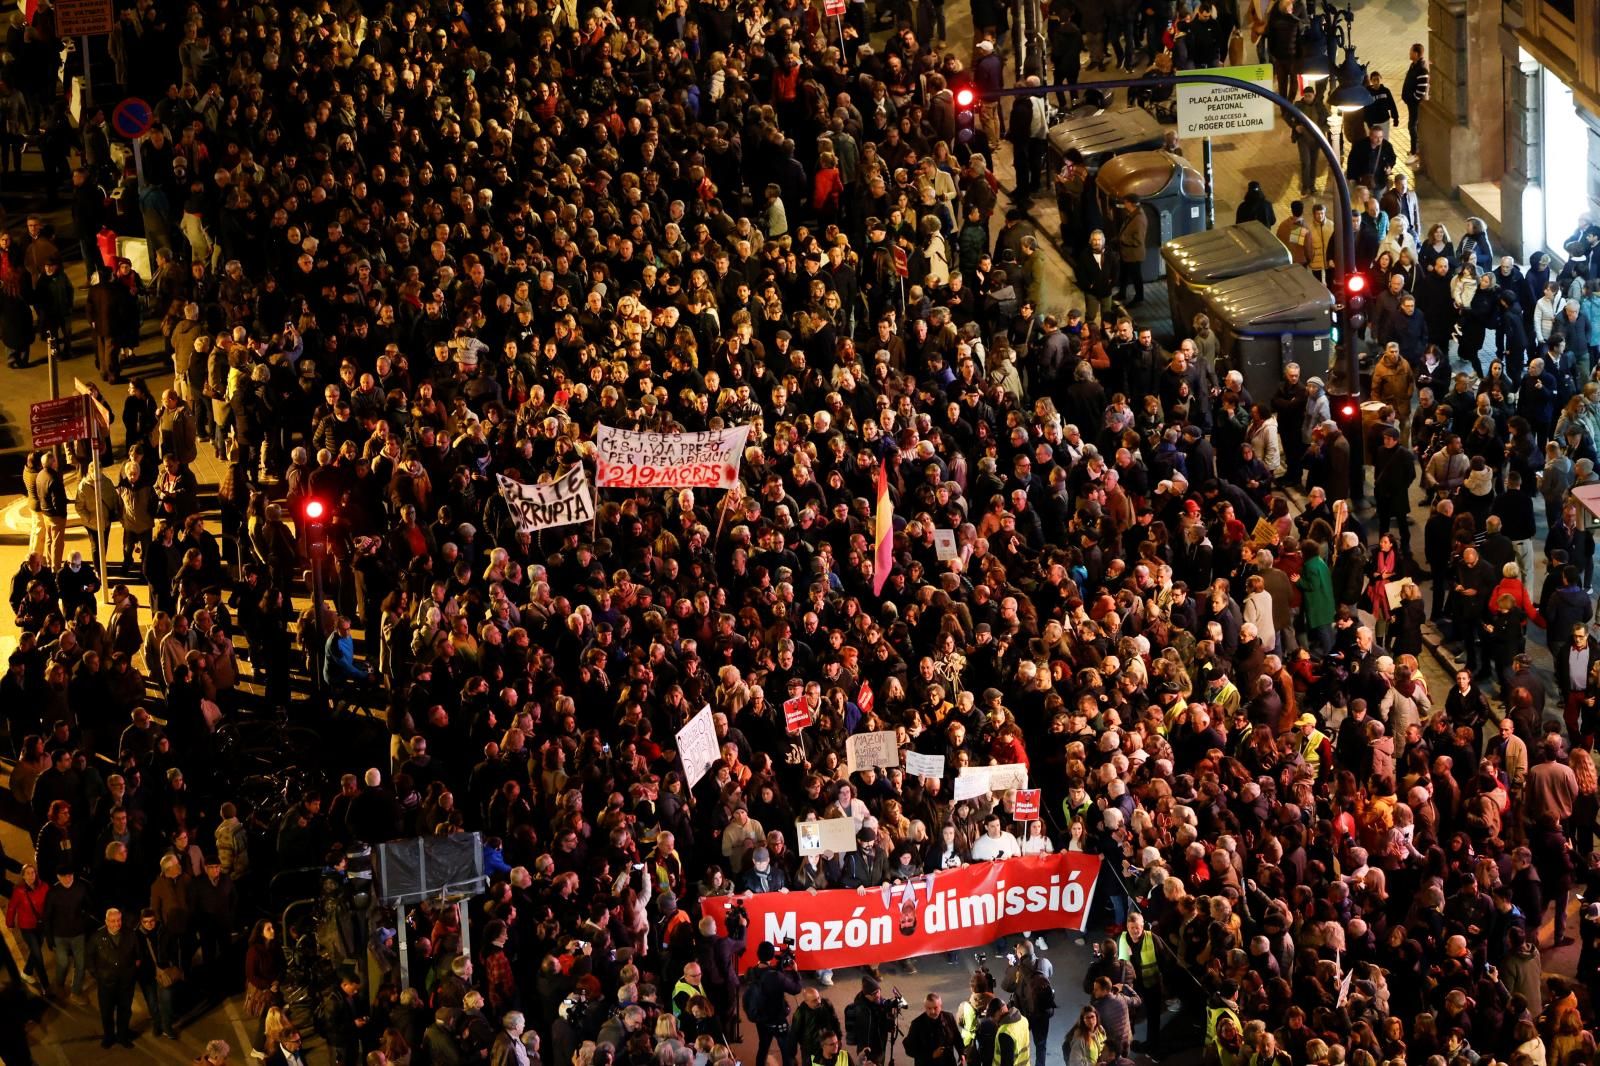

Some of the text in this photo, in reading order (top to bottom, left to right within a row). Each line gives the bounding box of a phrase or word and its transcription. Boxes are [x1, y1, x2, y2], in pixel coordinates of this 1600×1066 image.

[1189, 96, 1212, 104] PLAÇA
[1207, 102, 1243, 111] PEATONAL
[1220, 113, 1241, 121] ACCESO
[1188, 118, 1263, 132] C/ ROGER DE LLORIA
[608, 429, 725, 443] JUTGES DEL
[608, 451, 634, 465] PER
[764, 871, 1085, 952] Mazón dimissió
